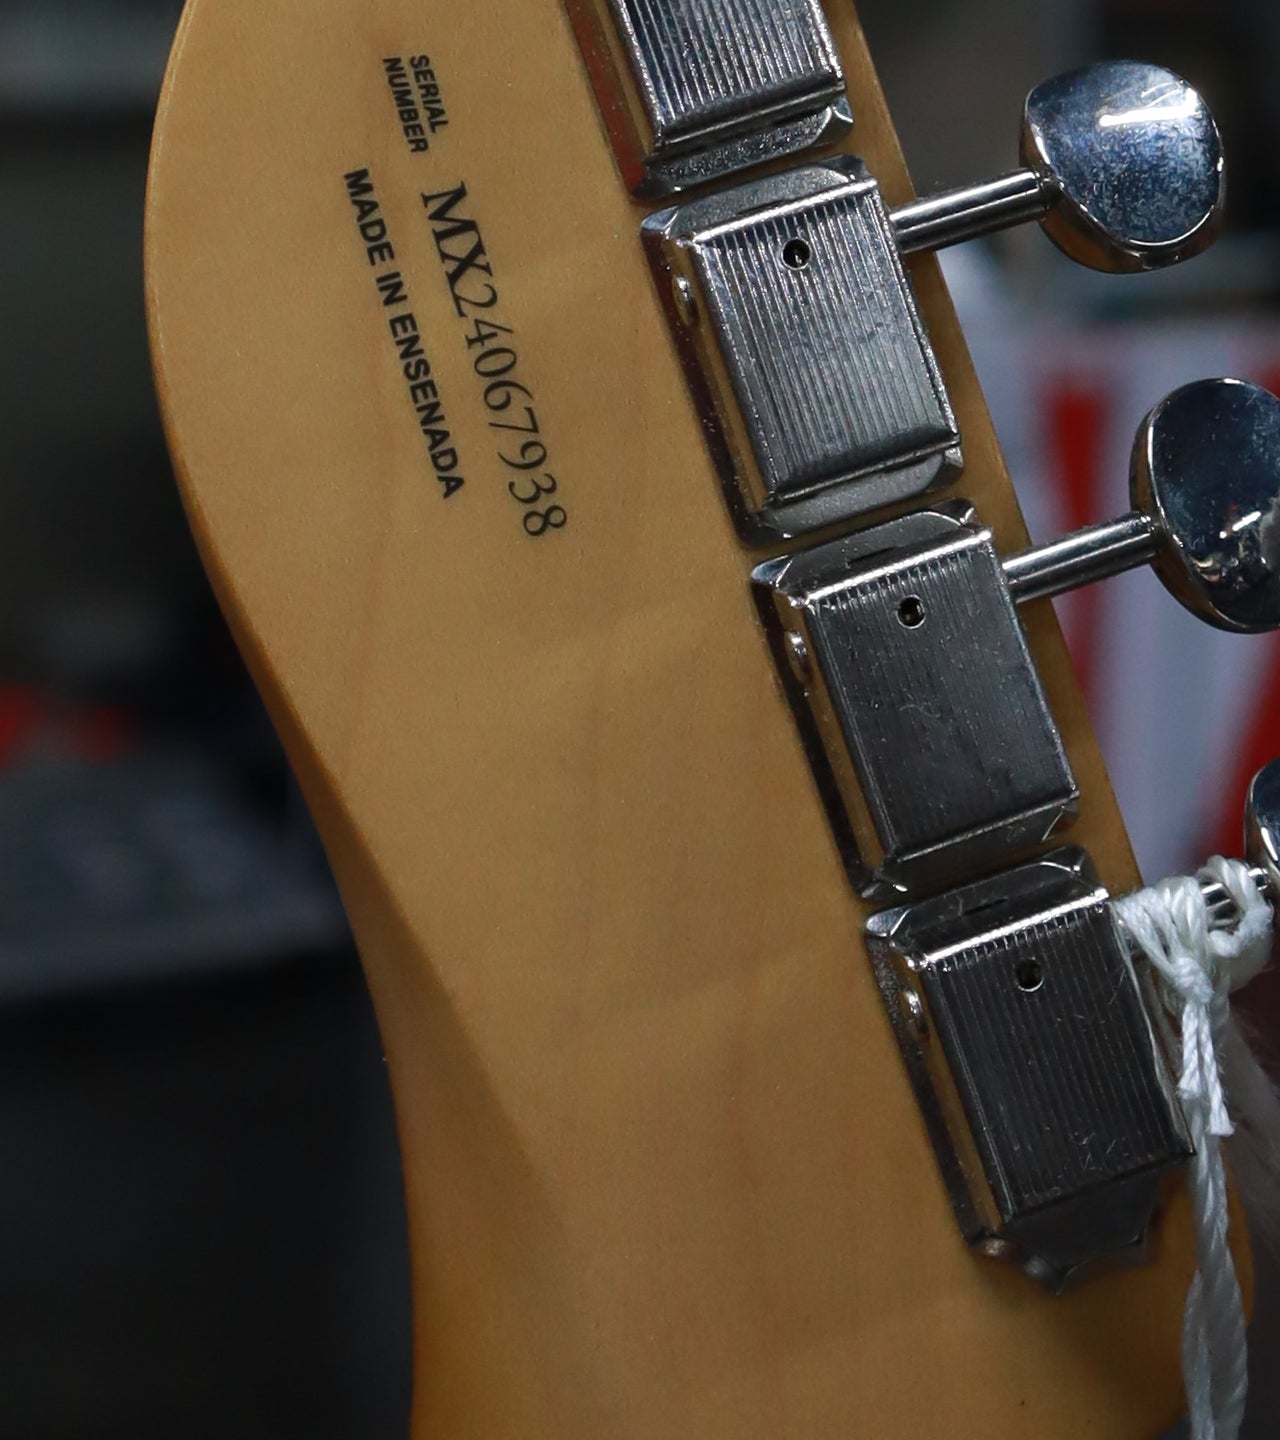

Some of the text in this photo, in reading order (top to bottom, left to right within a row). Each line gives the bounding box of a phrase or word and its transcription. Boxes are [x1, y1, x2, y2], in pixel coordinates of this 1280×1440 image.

[381, 56, 429, 153] NUMBER
[408, 54, 449, 134] SERIAL
[343, 167, 465, 500] MADE IN ENSENADA
[420, 180, 568, 537] MX24067938
